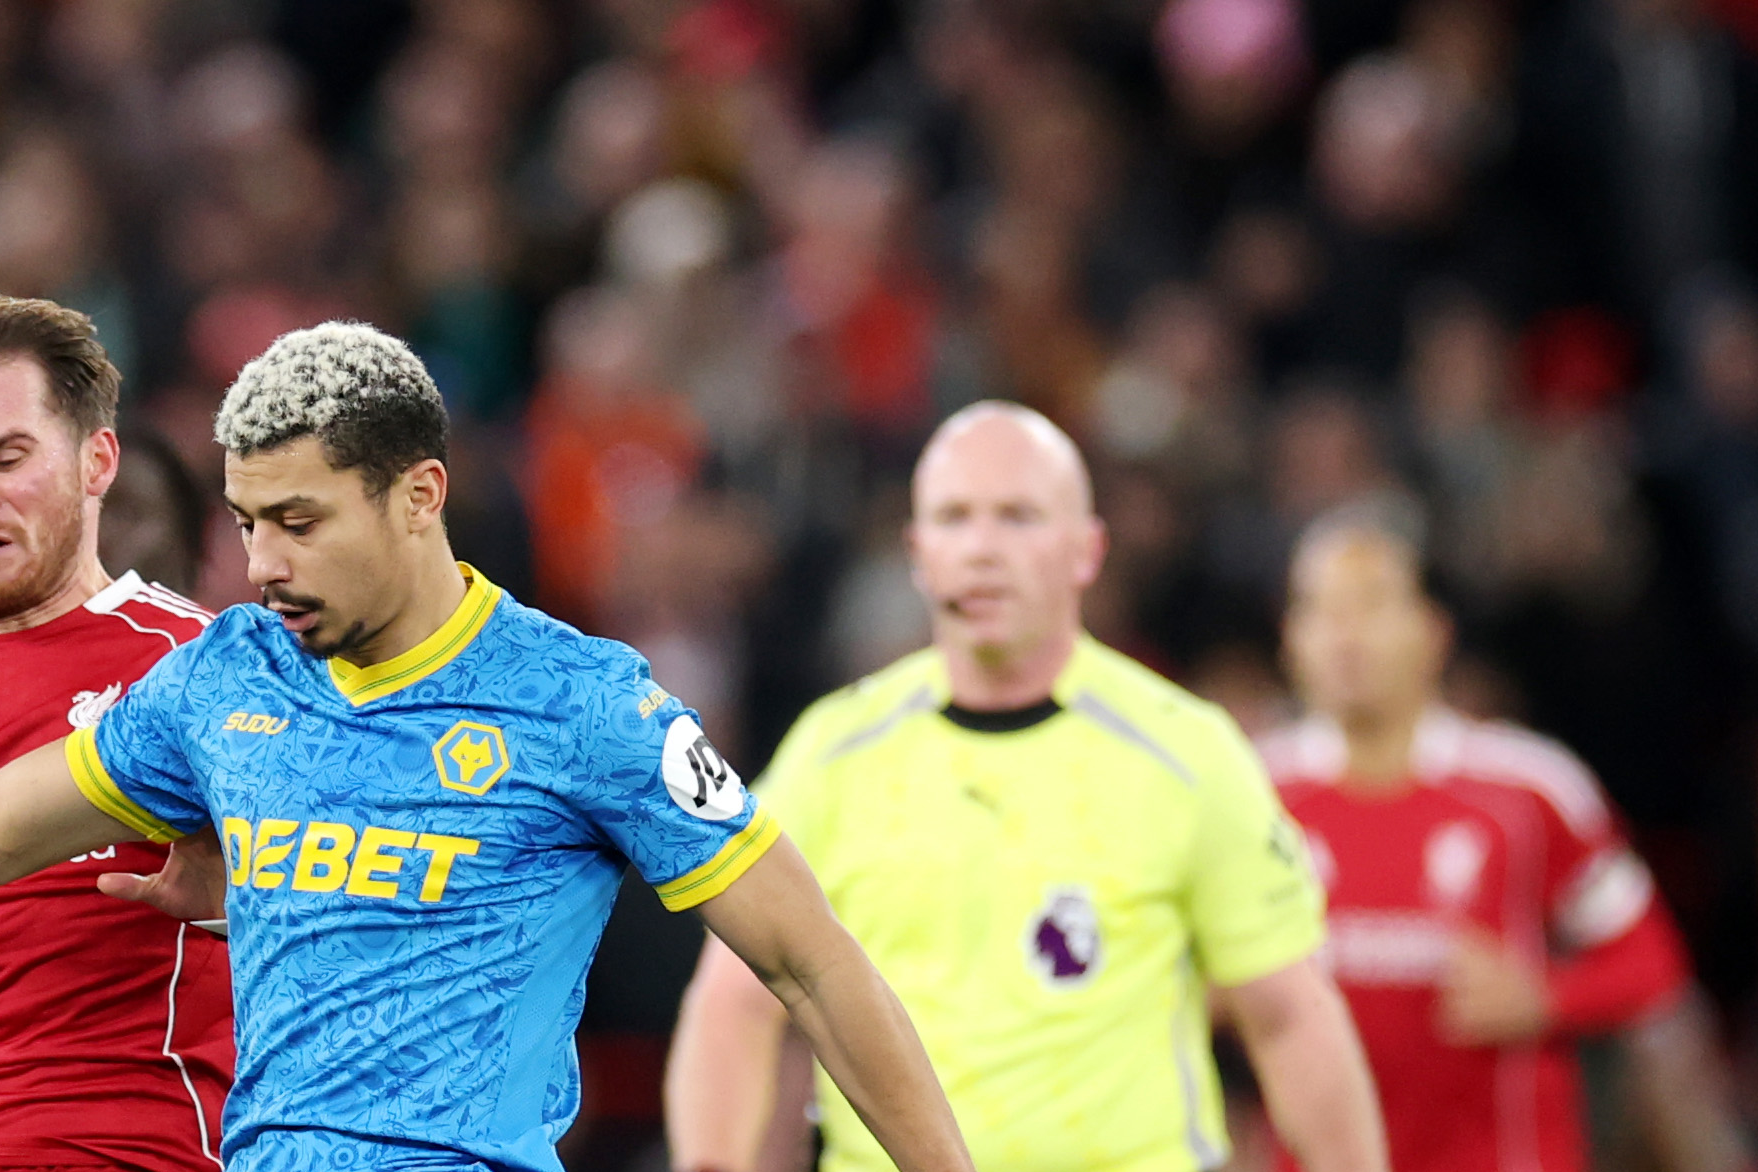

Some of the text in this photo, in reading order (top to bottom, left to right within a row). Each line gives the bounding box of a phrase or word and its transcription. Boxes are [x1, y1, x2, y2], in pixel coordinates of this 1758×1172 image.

[223, 712, 291, 735] SUDU
[685, 735, 728, 808] JD
[222, 817, 482, 903] DEBET
